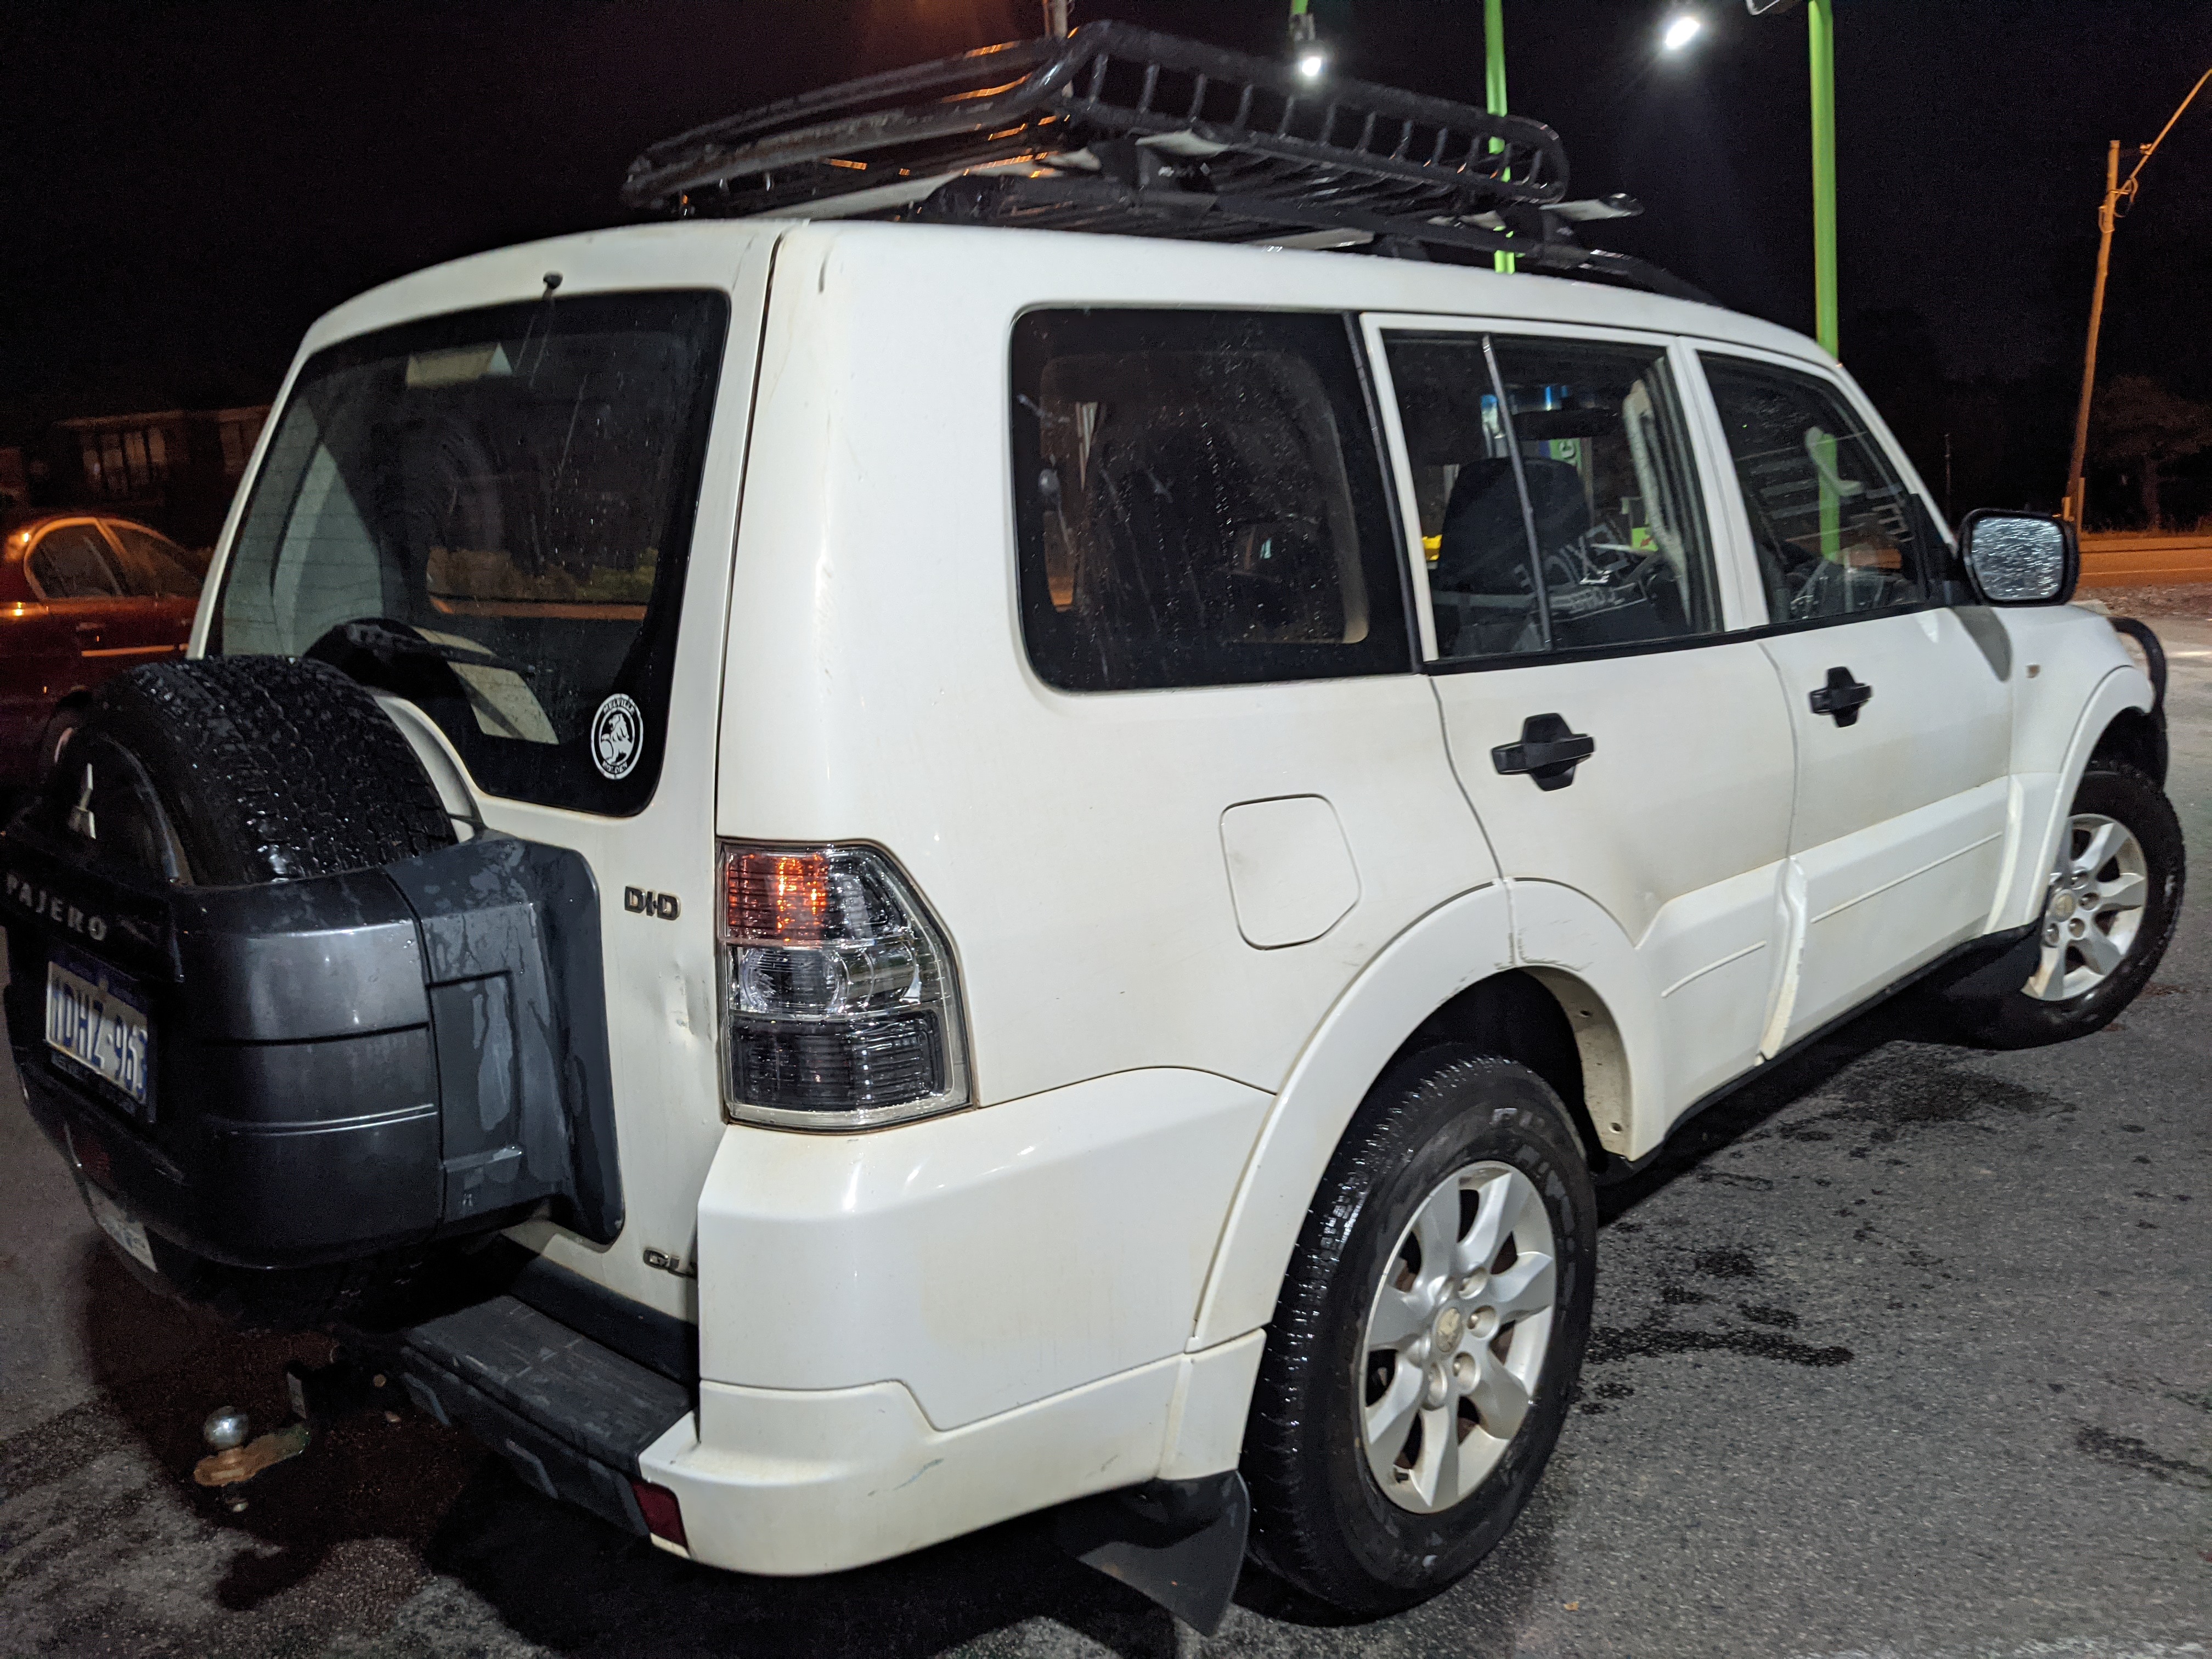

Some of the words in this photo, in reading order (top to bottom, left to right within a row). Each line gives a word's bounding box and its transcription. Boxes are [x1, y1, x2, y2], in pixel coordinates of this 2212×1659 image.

[603, 698, 635, 715] MELVILLE
[602, 760, 628, 774] HOLDEN
[6, 873, 108, 941] PAJERO
[643, 1250, 697, 1279] GL
